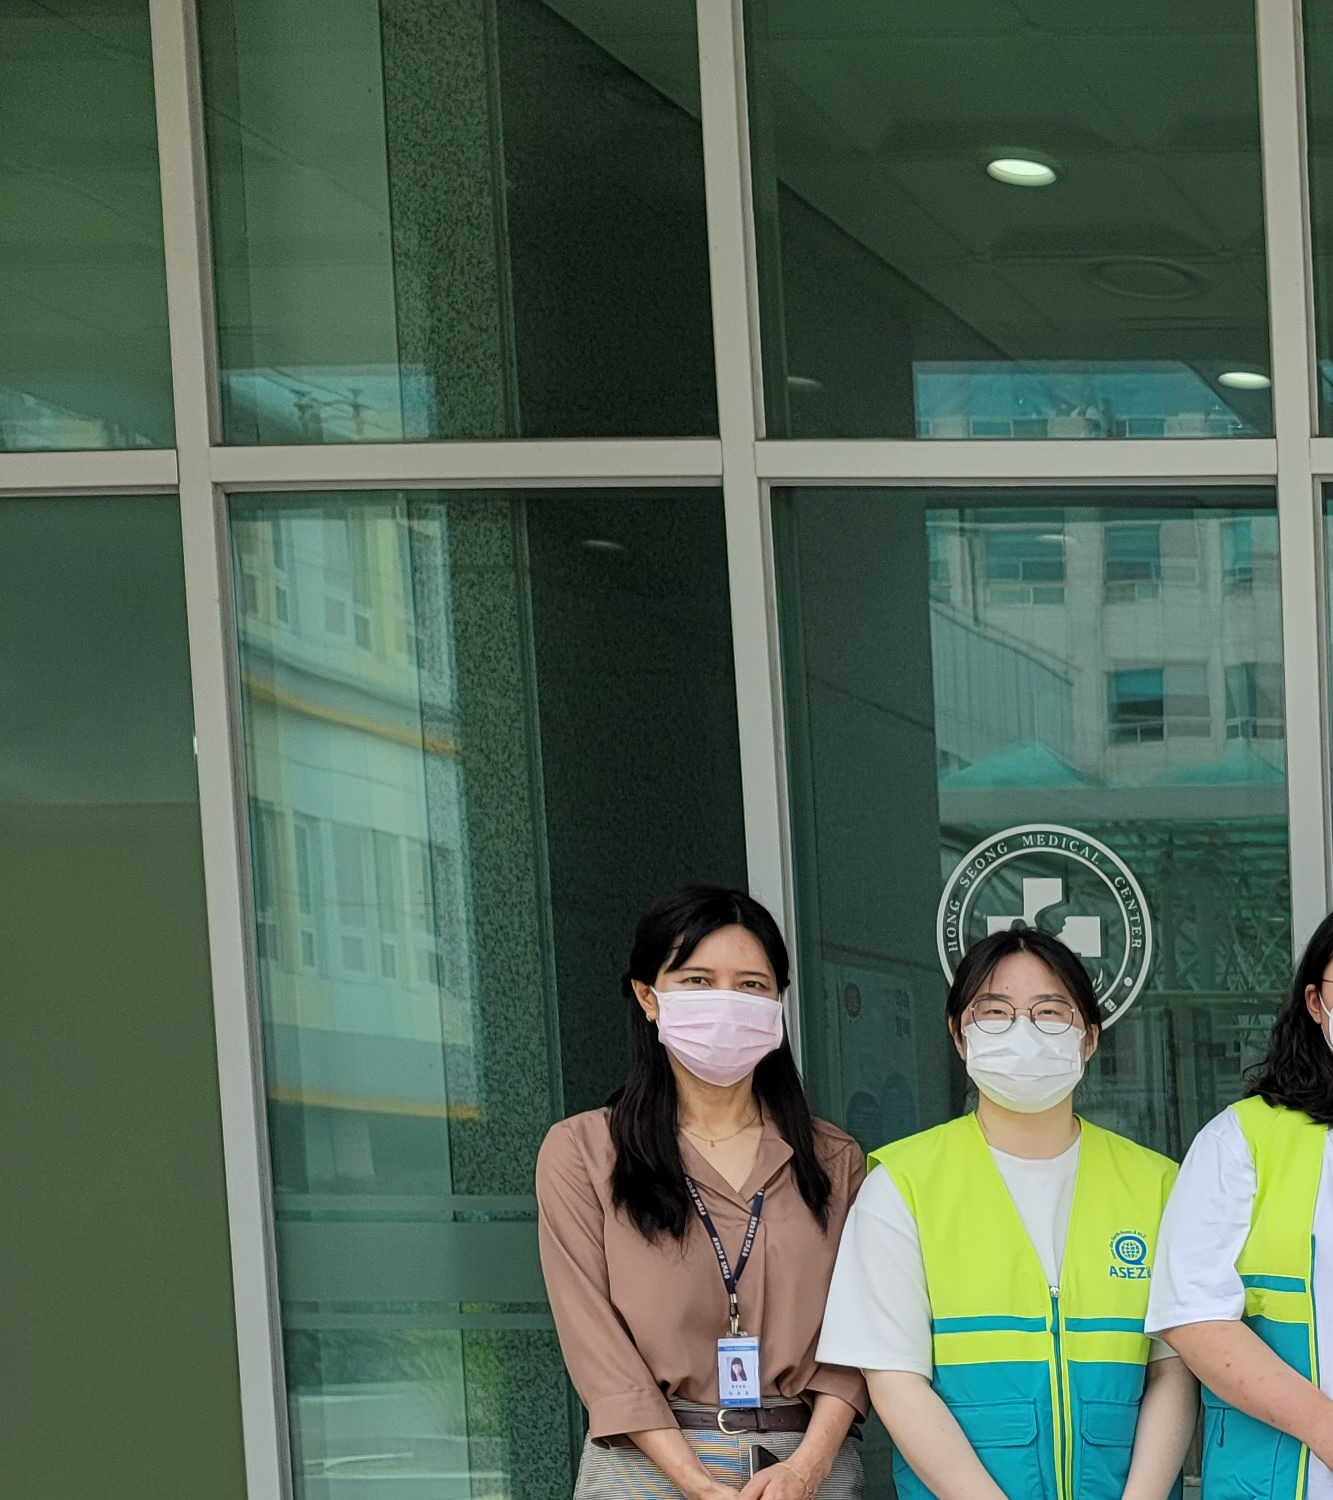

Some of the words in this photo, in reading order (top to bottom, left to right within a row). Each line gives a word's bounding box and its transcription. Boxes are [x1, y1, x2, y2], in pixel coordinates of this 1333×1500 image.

[948, 900, 961, 953] HONG
[960, 842, 1008, 888] SEONG
[1021, 834, 1101, 865] MEDICAL
[1114, 877, 1142, 949] CENTER
